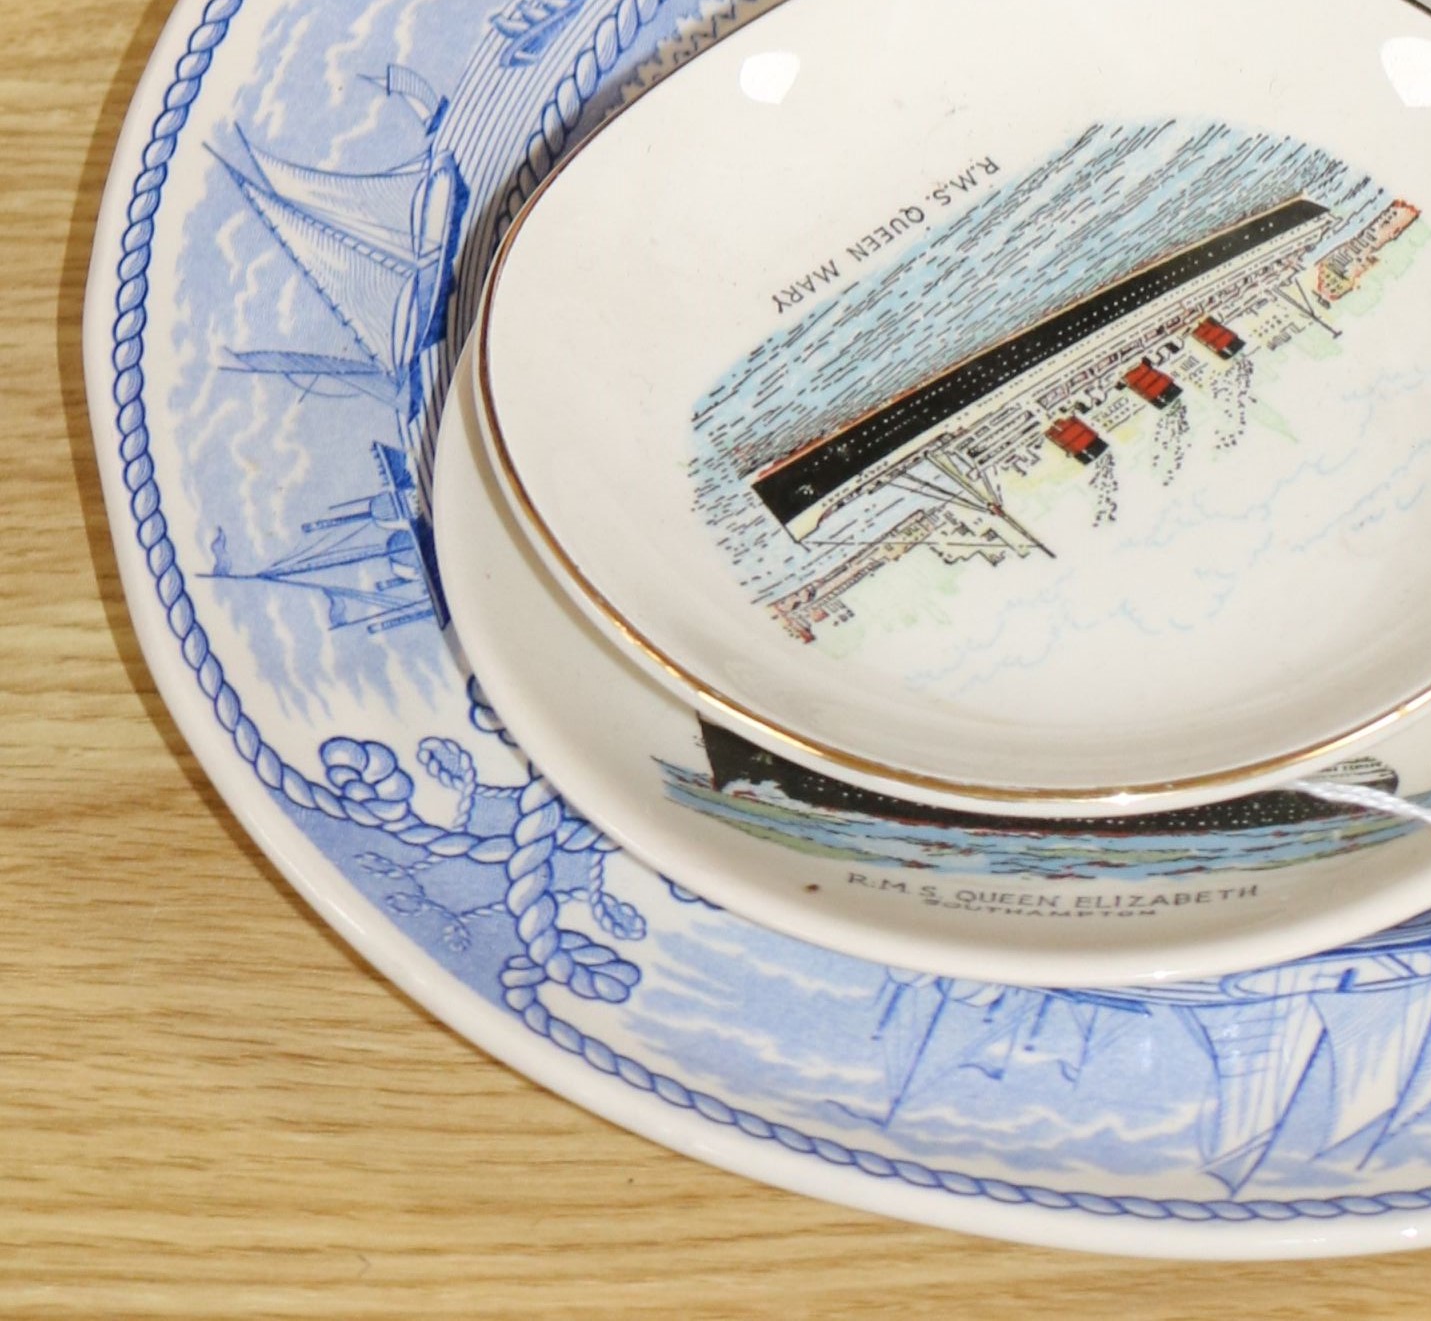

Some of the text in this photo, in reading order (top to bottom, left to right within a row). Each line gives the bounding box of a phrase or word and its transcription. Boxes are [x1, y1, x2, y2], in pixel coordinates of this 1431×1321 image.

[771, 156, 1000, 315] R.M.S. QUEEN MARY
[922, 898, 1156, 918] SOUTHAMPTON
[956, 889, 1060, 908] QUEEN
[1074, 885, 1258, 909] ELIZABETH
